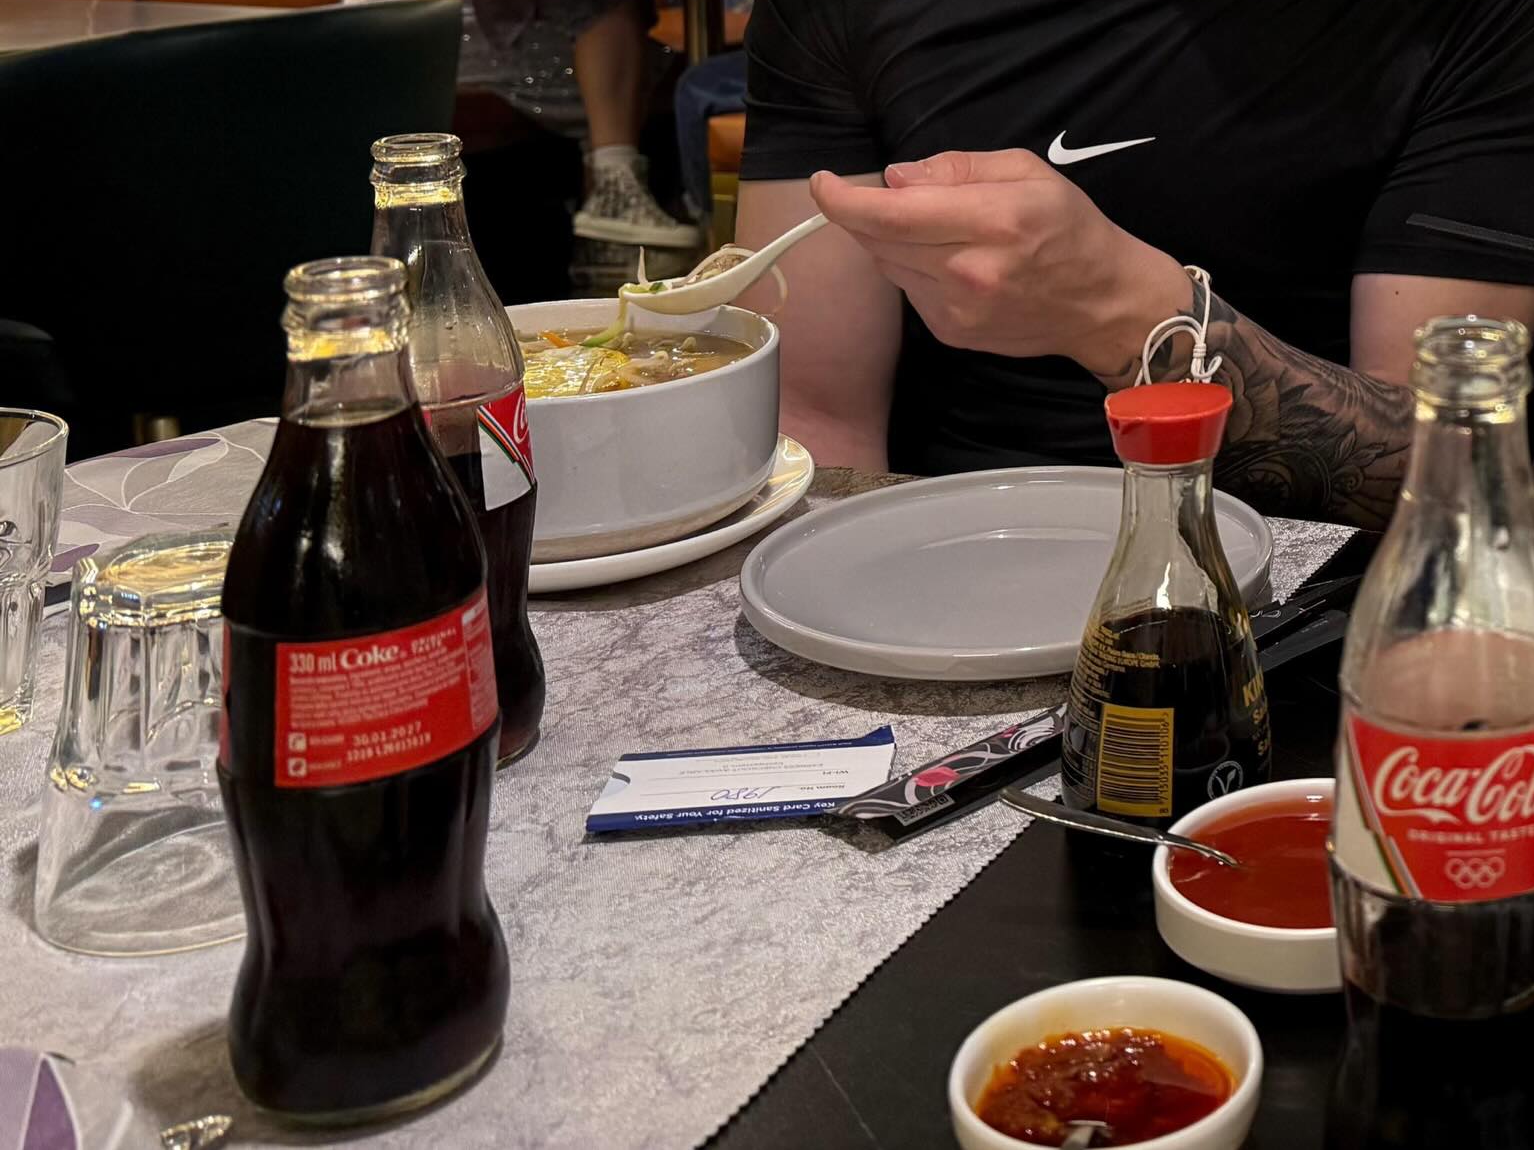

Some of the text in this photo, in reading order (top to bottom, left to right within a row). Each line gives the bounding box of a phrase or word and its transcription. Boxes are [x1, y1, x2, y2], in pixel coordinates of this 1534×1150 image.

[289, 652, 315, 674] 330
[726, 805, 781, 815] Sanitized
[815, 801, 835, 809] Key
[676, 809, 702, 818] Your
[706, 806, 723, 817] for
